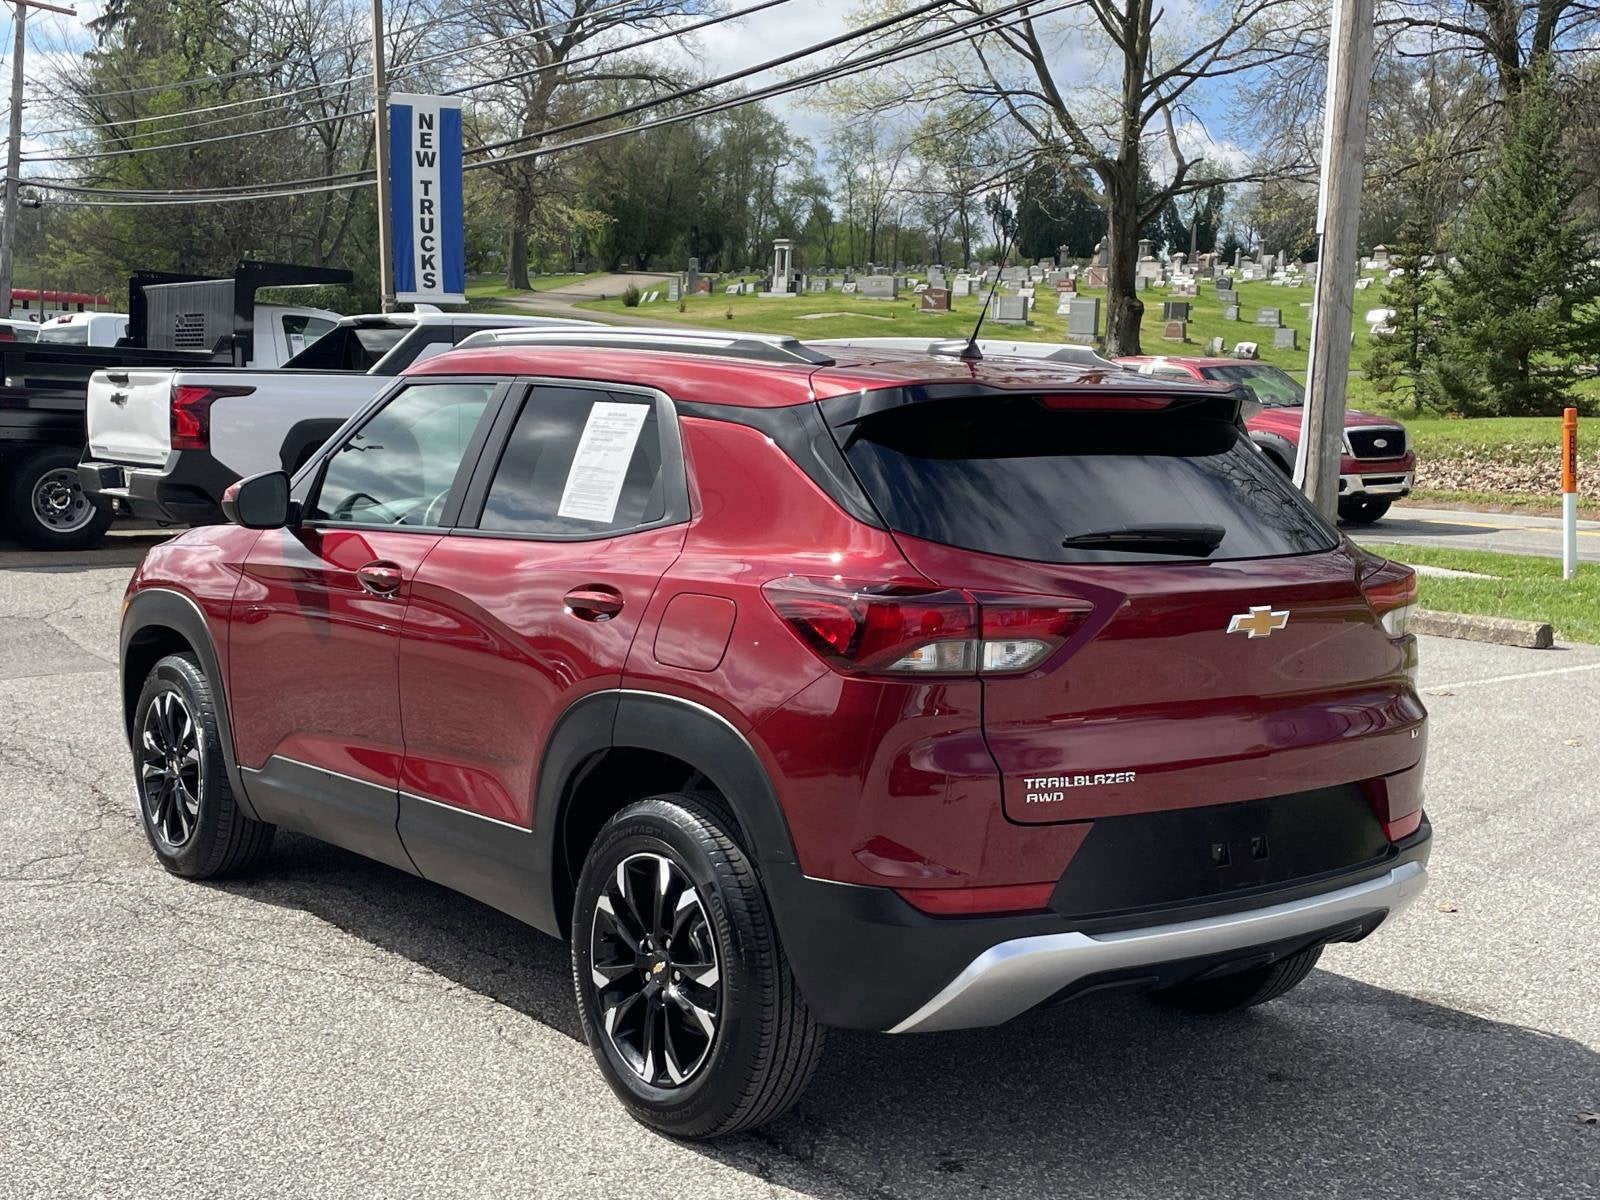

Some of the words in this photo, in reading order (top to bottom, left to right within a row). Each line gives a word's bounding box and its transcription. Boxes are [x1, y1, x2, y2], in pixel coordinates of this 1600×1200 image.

[416, 113, 437, 168] NEW
[420, 180, 437, 289] TRUCKS
[1024, 771, 1136, 790] TRAILBLAZER
[1026, 792, 1064, 804] AWD
